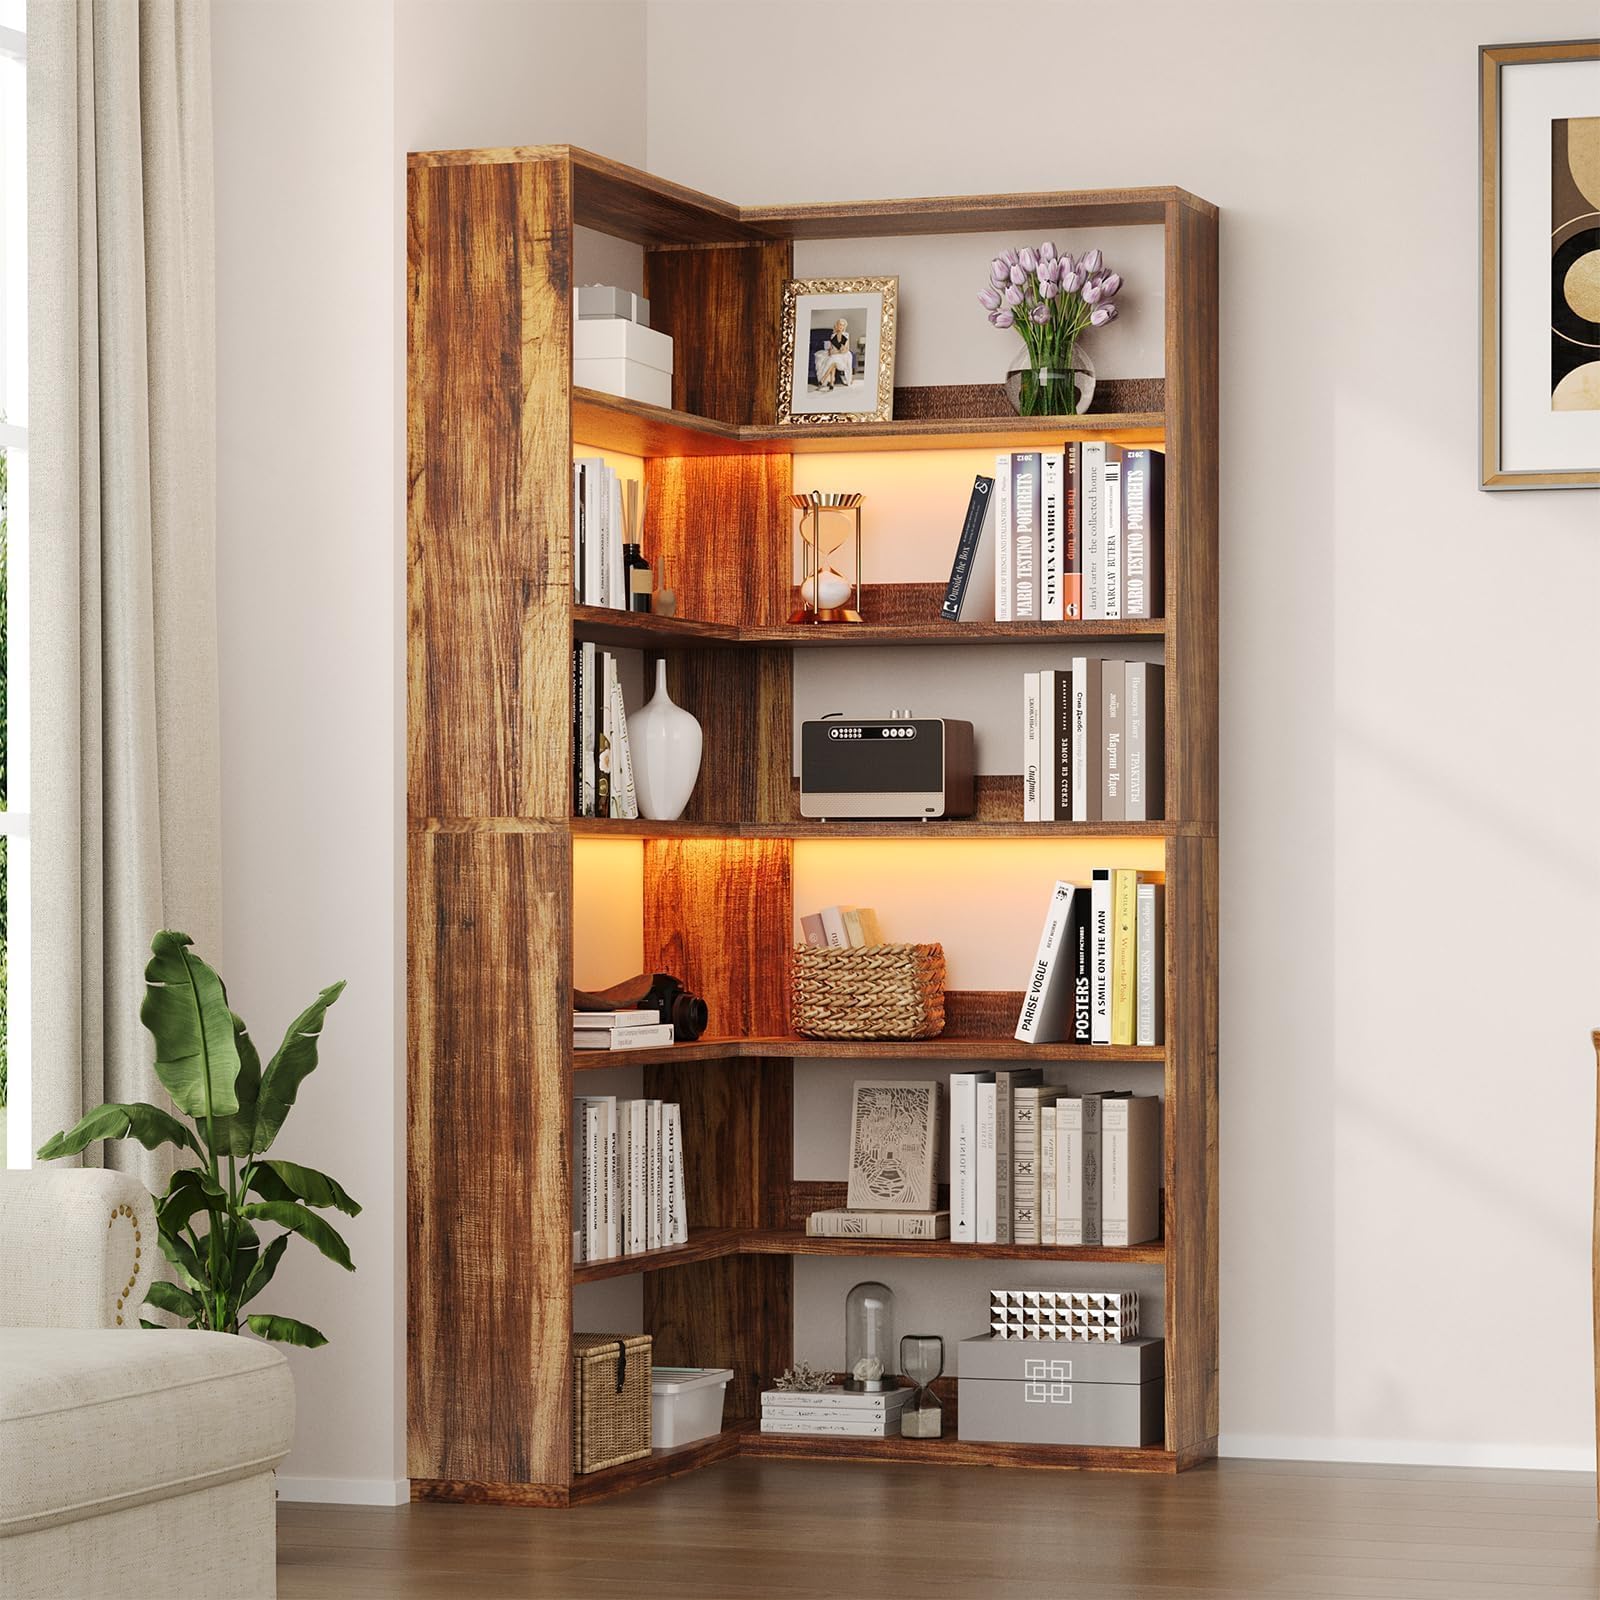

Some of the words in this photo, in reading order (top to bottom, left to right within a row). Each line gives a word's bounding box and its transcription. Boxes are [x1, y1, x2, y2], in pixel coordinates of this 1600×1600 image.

[1088, 466, 1097, 493] home
[1068, 488, 1076, 506] The
[1047, 494, 1055, 553] GAMBREL
[1068, 508, 1076, 535] Black
[1088, 496, 1097, 536] collected
[959, 545, 970, 561] Box
[1017, 535, 1032, 579] TESTINO
[1067, 536, 1076, 560] Tulip
[1088, 539, 1097, 553] the
[1107, 535, 1116, 567] BUTERA
[1128, 533, 1143, 577] TESTINO
[956, 561, 967, 574] the
[1047, 557, 1055, 605] STEVEN
[949, 574, 964, 601] Outside
[1017, 582, 1032, 616] MARIO
[1089, 587, 1099, 610] darryl
[1107, 572, 1116, 607] BARCLAY
[1128, 579, 1143, 614] MARIO
[1107, 733, 1120, 769] Мартин
[1108, 773, 1120, 797] Иден
[1098, 910, 1106, 930] MAN
[1098, 937, 1106, 955] THE
[1098, 959, 1106, 973] ON
[1021, 995, 1040, 1032] PARISE
[1031, 960, 1048, 993] VOGUE
[1098, 976, 1106, 1006] SMILE
[1076, 977, 1089, 1039] POSTERS
